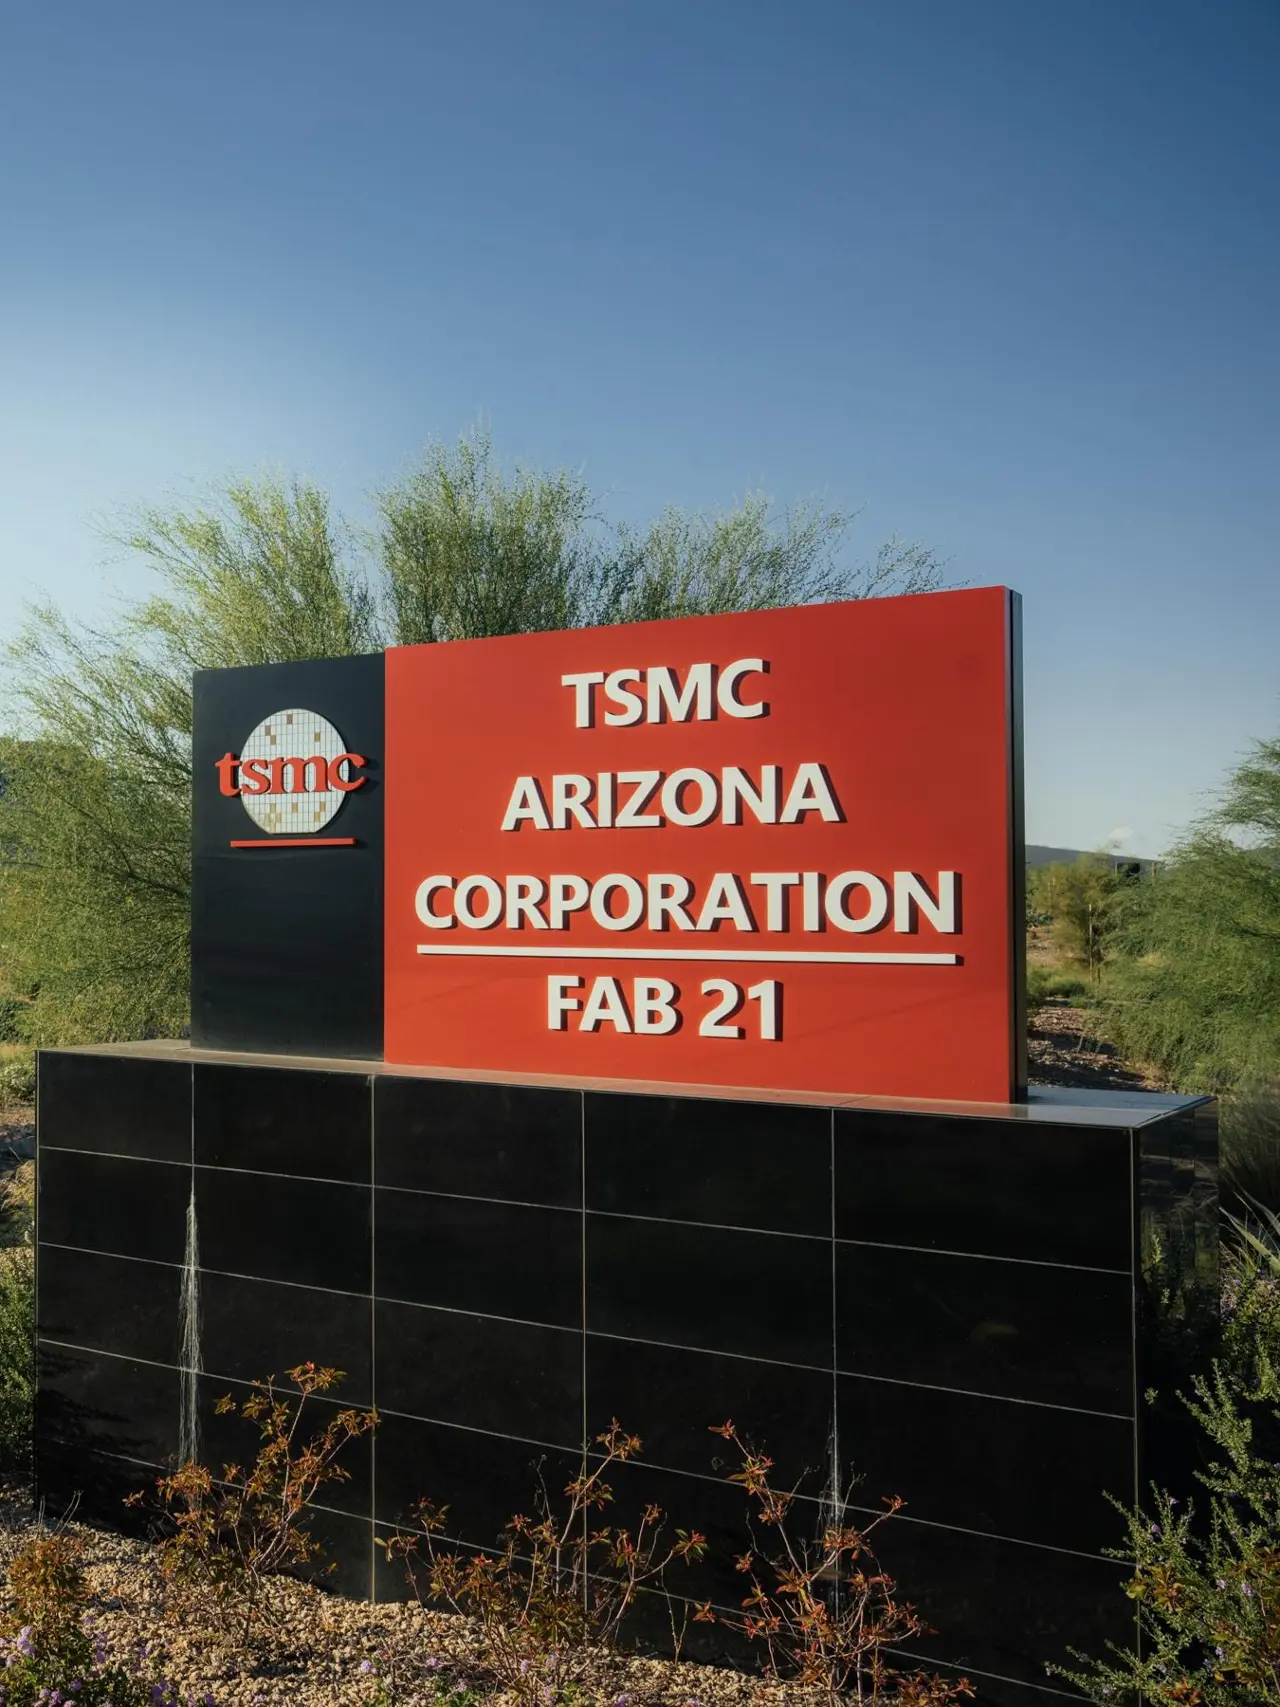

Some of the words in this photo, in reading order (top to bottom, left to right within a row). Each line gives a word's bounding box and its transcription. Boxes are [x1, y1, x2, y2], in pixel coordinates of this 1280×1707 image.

[561, 658, 766, 728] TSMC
[215, 752, 366, 797] tsmc
[501, 763, 840, 831] ARIZONA
[415, 870, 957, 934] CORPORATION
[547, 974, 679, 1035] FAB
[699, 978, 780, 1040] 21
